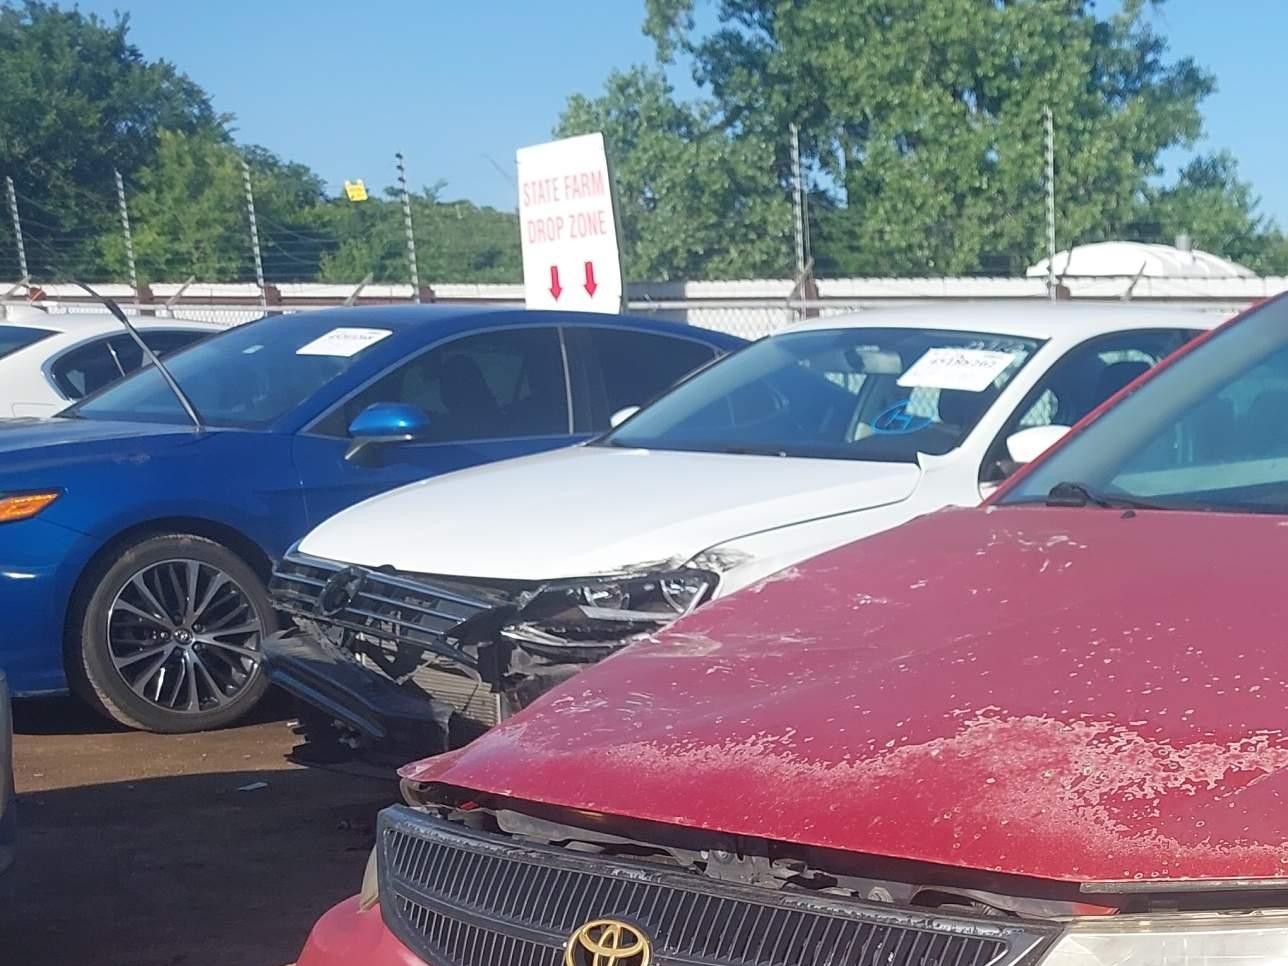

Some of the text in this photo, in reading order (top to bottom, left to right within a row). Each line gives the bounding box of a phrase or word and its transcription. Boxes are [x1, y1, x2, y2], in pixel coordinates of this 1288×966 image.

[524, 171, 604, 207] STATE FARM
[527, 211, 607, 244] DROP ZONE
